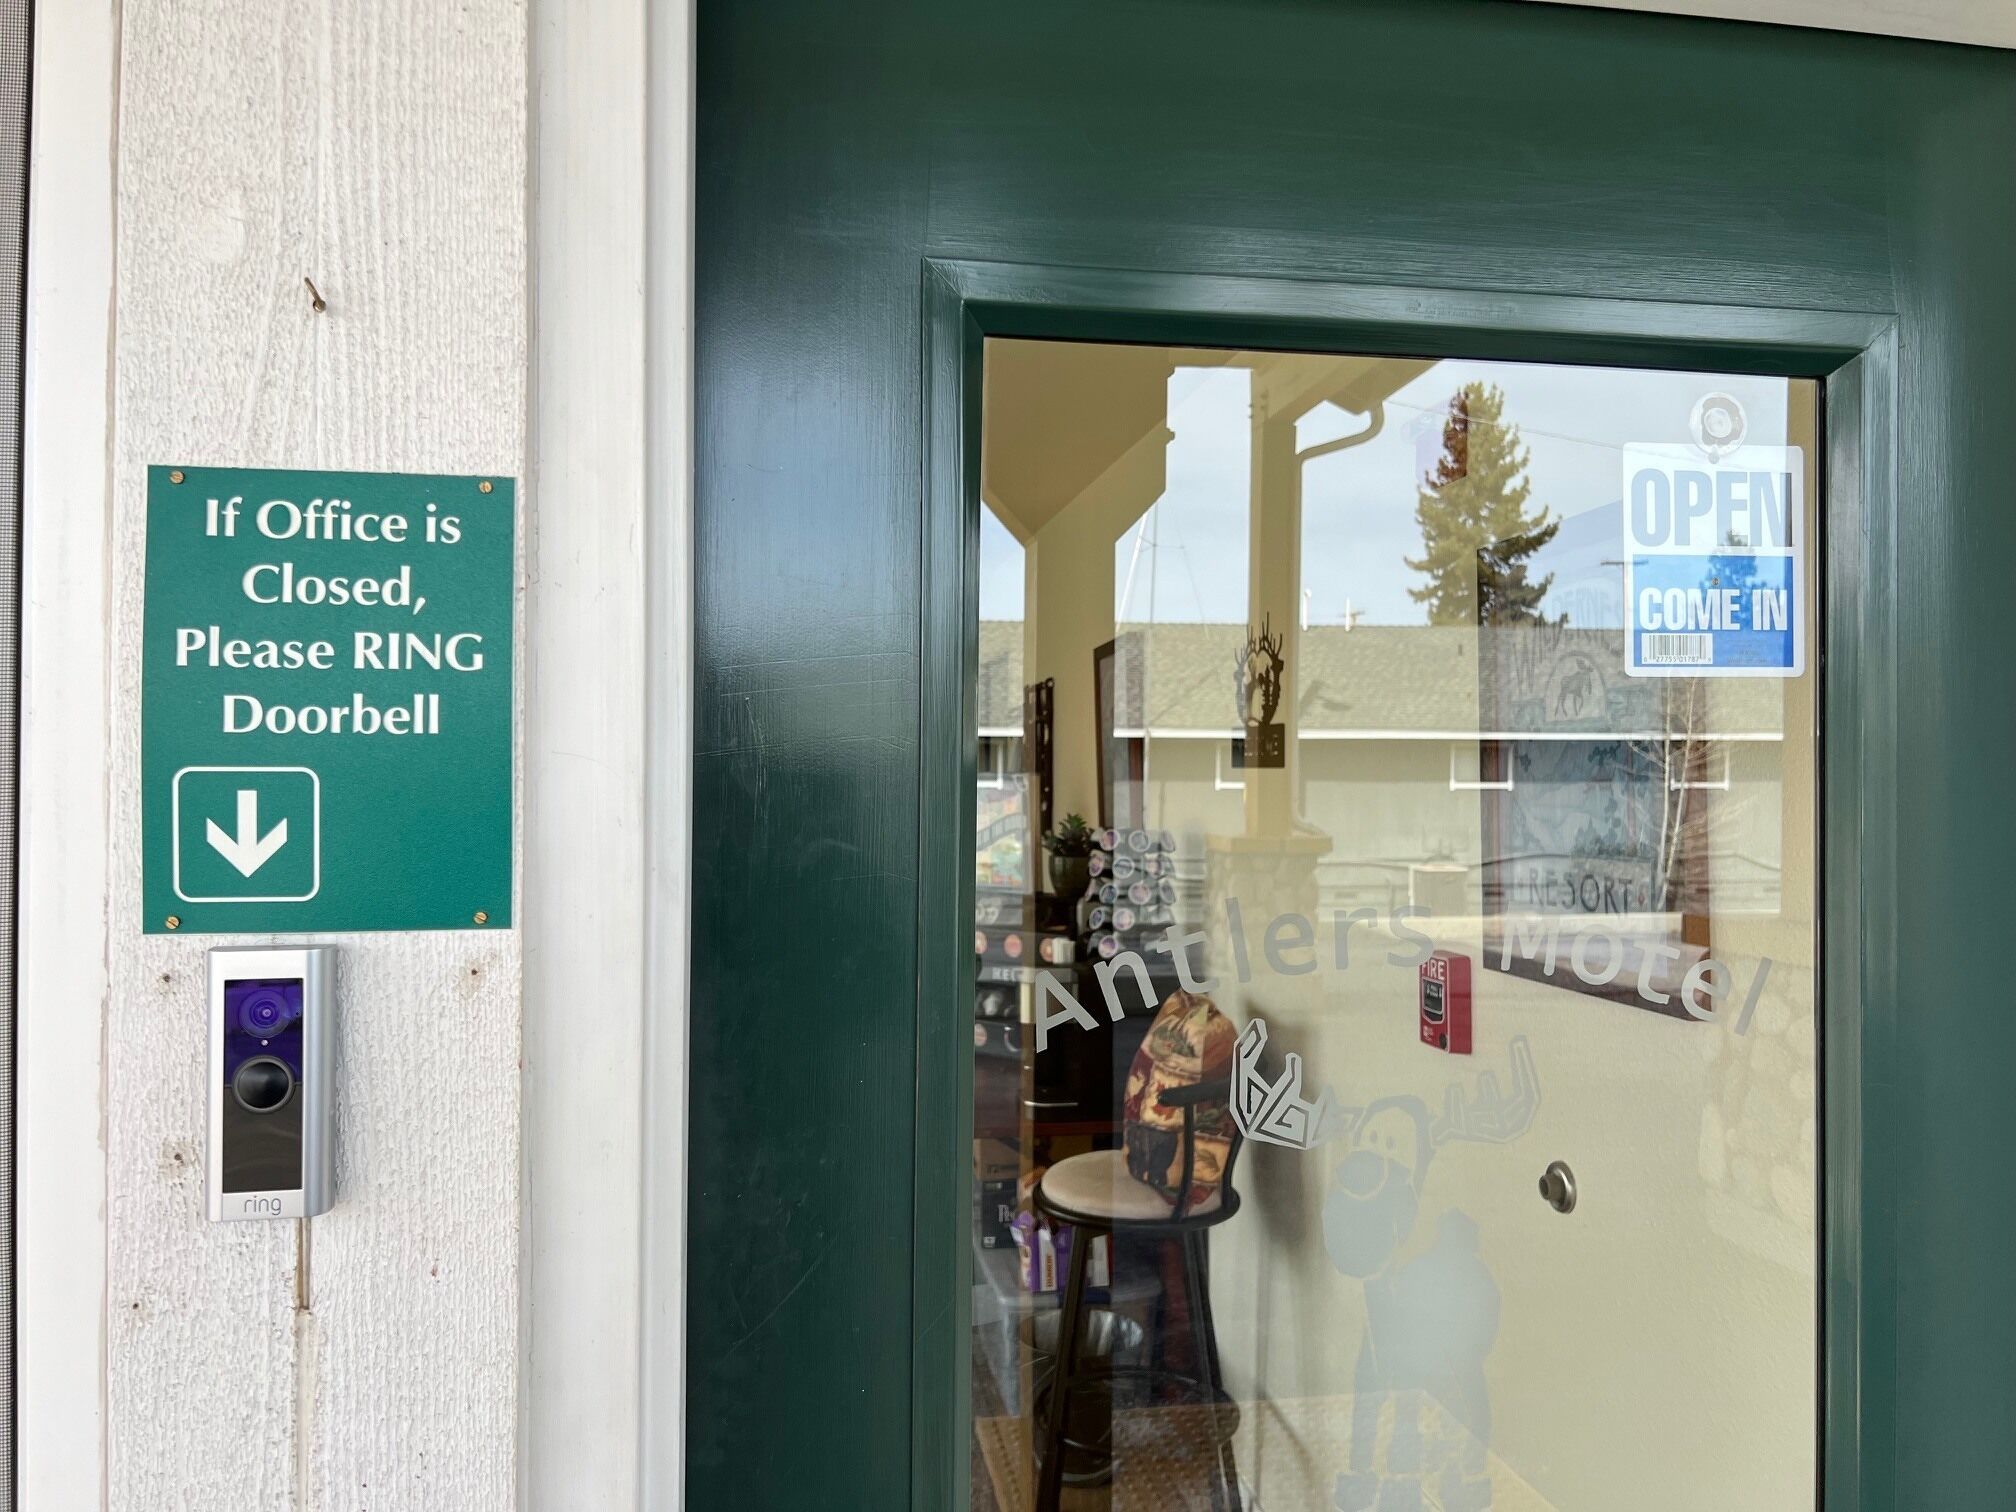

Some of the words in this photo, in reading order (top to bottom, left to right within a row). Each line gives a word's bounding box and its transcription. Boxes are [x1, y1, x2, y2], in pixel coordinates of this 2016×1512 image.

[204, 496, 242, 537] If
[255, 498, 408, 543] Office
[425, 503, 463, 544] is
[1630, 467, 1793, 548] OPEN
[242, 562, 427, 614] Closed,
[1639, 587, 1742, 631] COME
[1752, 589, 1788, 631] IN
[175, 626, 335, 669] Please
[353, 631, 484, 672] RING
[221, 692, 440, 735] Doorbell
[1529, 867, 1633, 915] RESORT
[1033, 896, 1435, 1053] Antlers
[1500, 903, 1773, 1036] Motel
[1421, 958, 1446, 981] FIRE
[243, 1195, 282, 1216] ring
